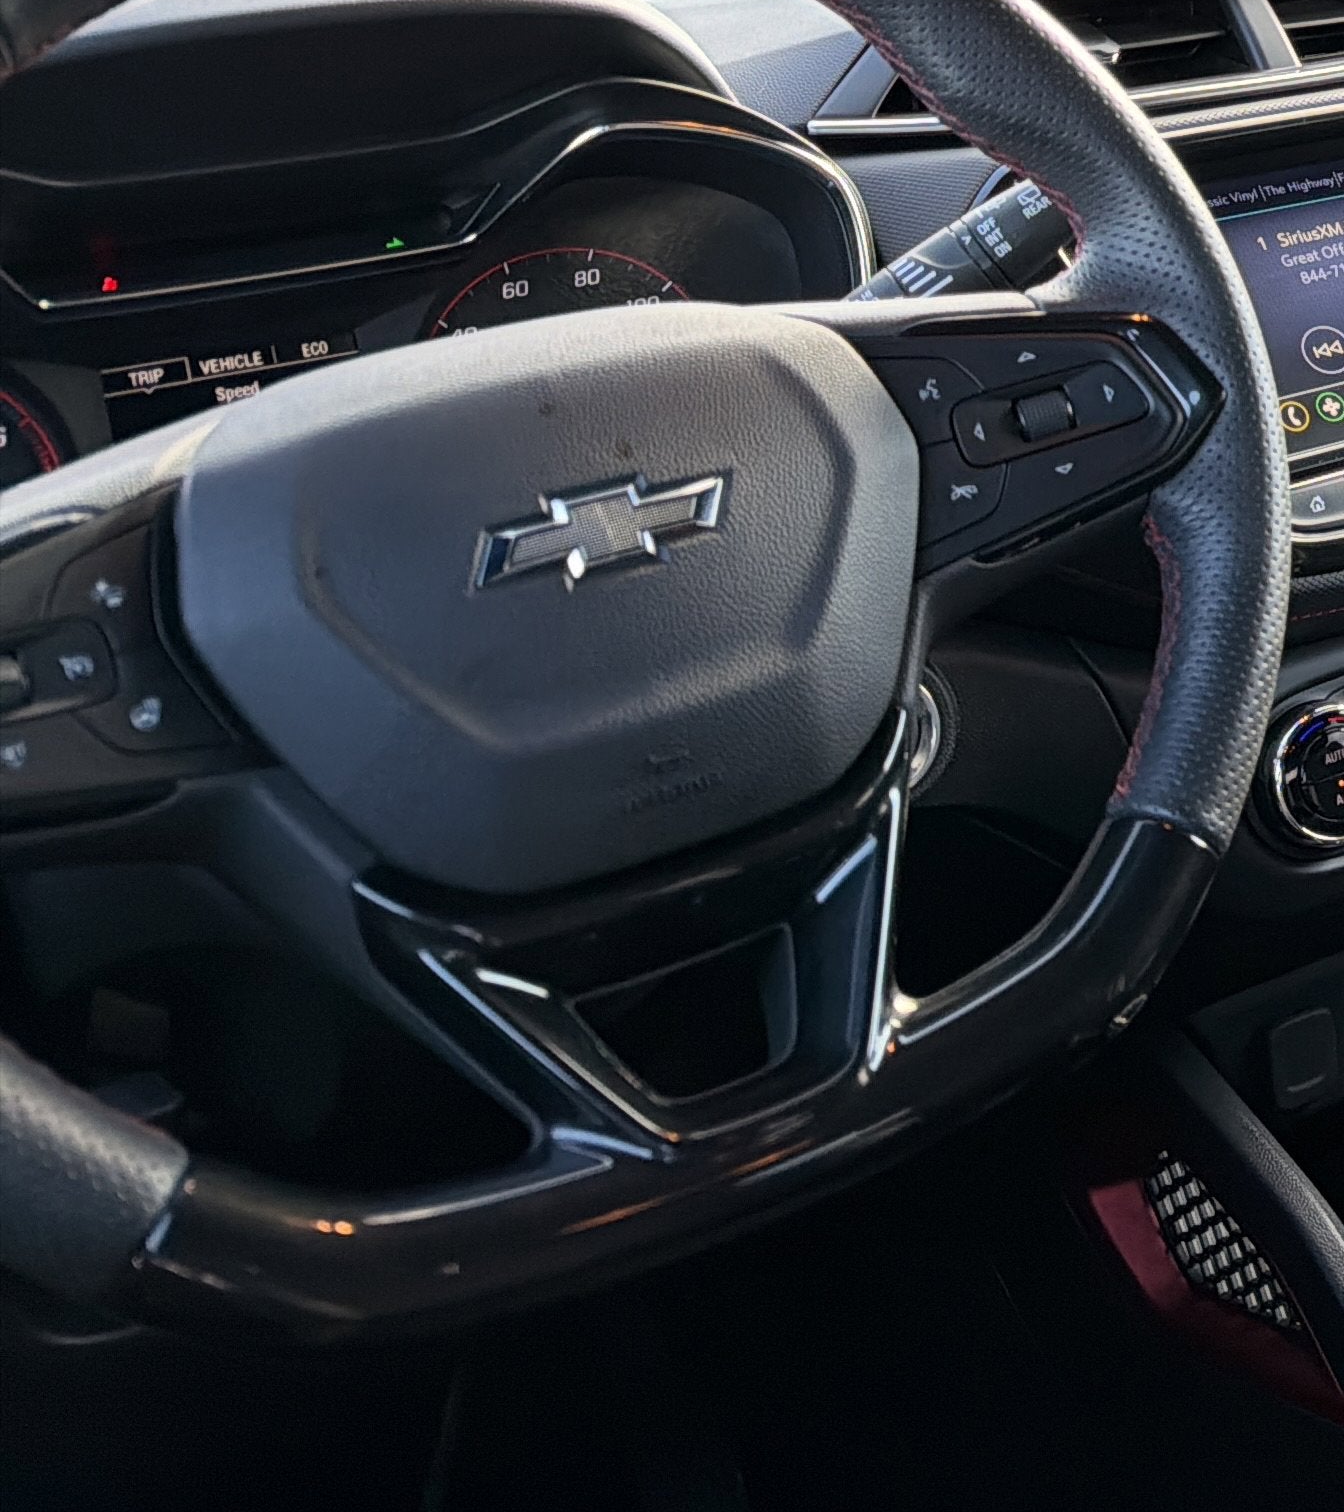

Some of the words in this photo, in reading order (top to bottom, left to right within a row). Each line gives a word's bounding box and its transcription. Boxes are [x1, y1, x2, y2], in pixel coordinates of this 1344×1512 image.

[1207, 195, 1230, 208] ssic
[1229, 187, 1259, 204] Vinyl
[1262, 185, 1287, 197] The
[1286, 177, 1335, 193] Highway
[1022, 196, 1053, 220] REAR
[976, 216, 997, 236] OFF
[1256, 237, 1269, 252] 1
[1276, 222, 1344, 248] SiriusXM
[1280, 250, 1320, 269] Great
[502, 279, 529, 299] 60
[573, 268, 600, 288] 80
[127, 367, 165, 388] TRIP
[199, 350, 265, 376] VEHICLE
[301, 340, 329, 358] ECO
[214, 380, 261, 404] Speed
